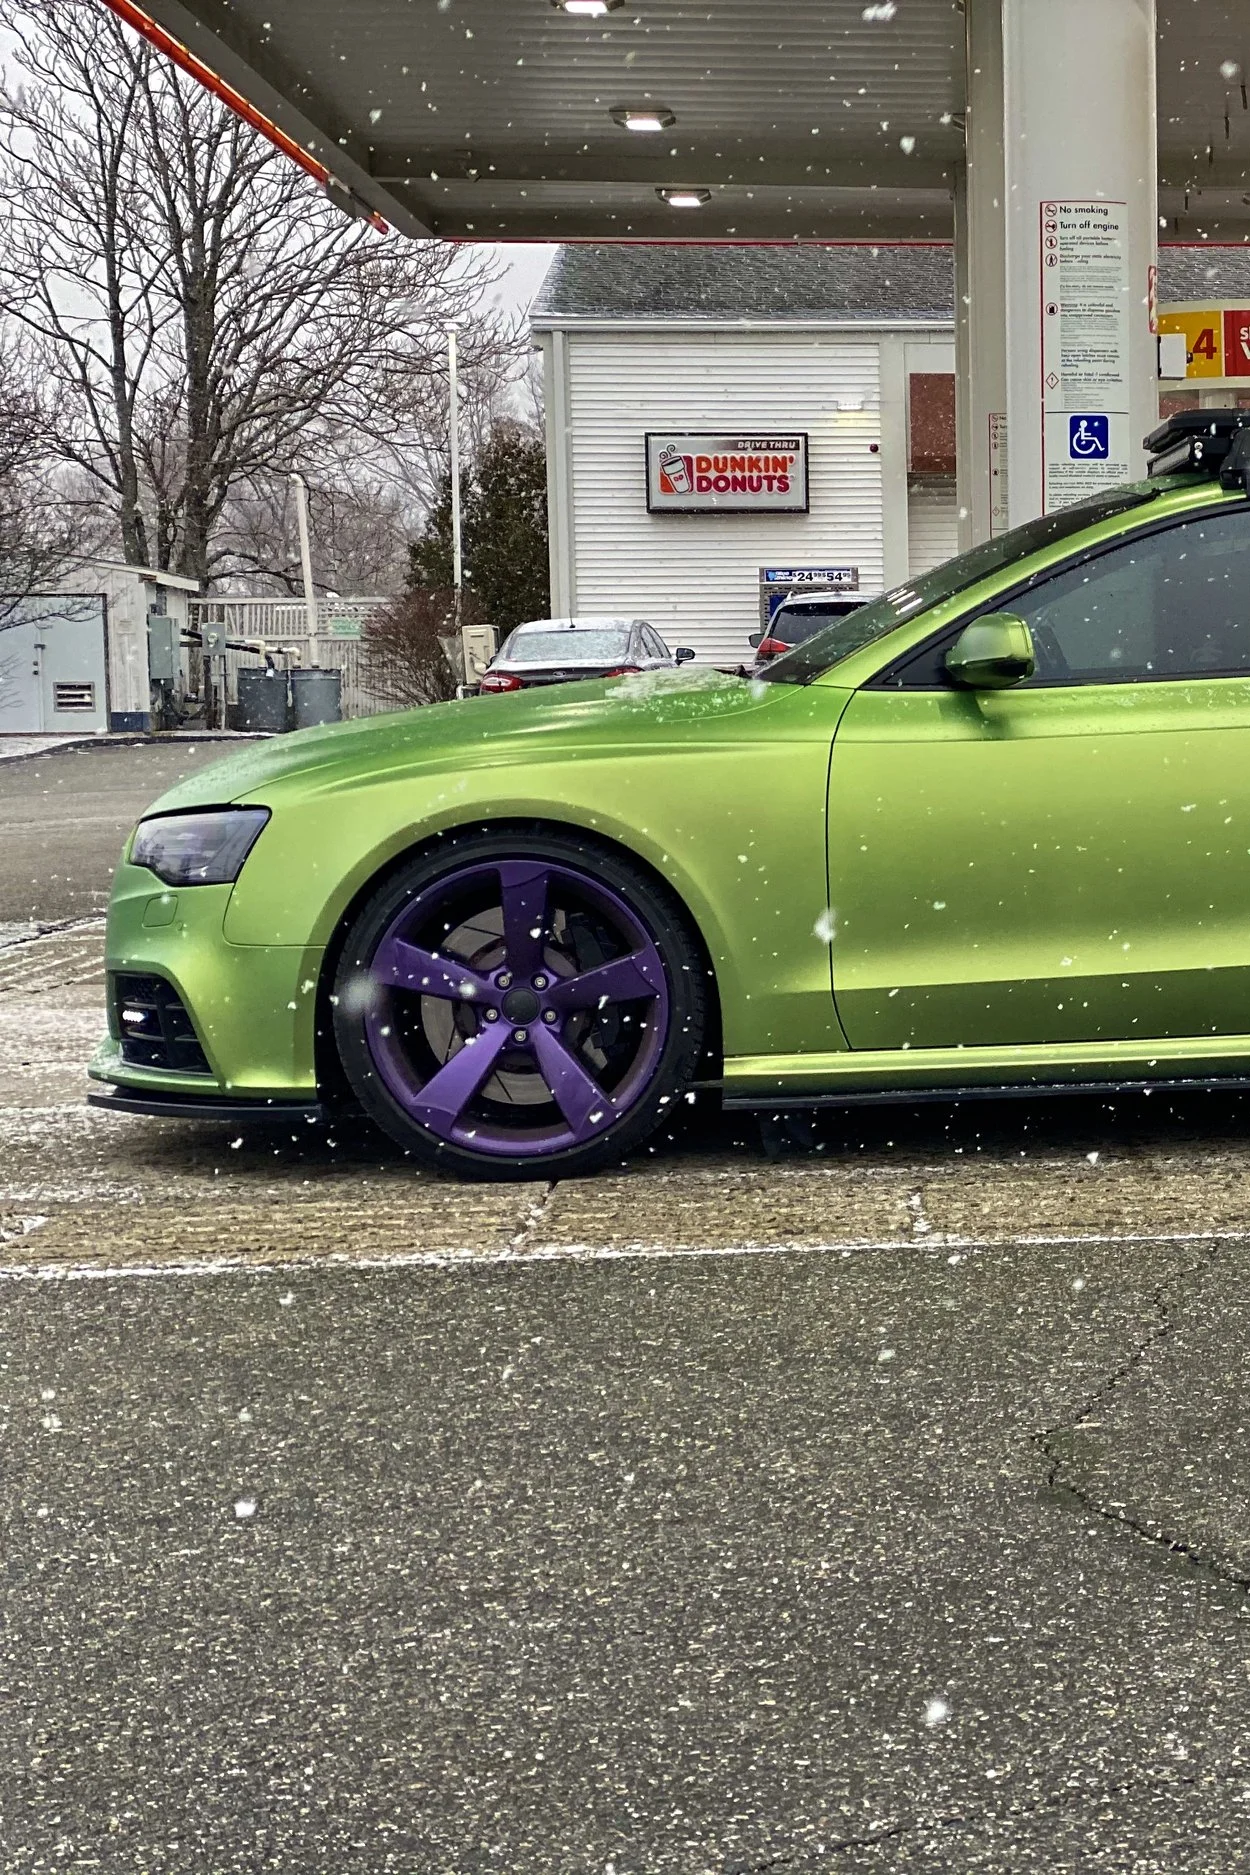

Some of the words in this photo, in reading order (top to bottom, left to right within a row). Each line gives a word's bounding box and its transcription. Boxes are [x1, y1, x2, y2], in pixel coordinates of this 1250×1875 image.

[1060, 205, 1072, 214] No
[1074, 205, 1109, 216] smoking
[1060, 221, 1077, 229] Turn
[1079, 220, 1091, 229] off
[1093, 222, 1119, 231] engine
[1193, 328, 1217, 360] 4
[738, 441, 767, 449] DRIVE
[770, 441, 796, 449] THRU
[696, 455, 795, 474] DUNKIN'
[696, 474, 790, 493] DONUTS
